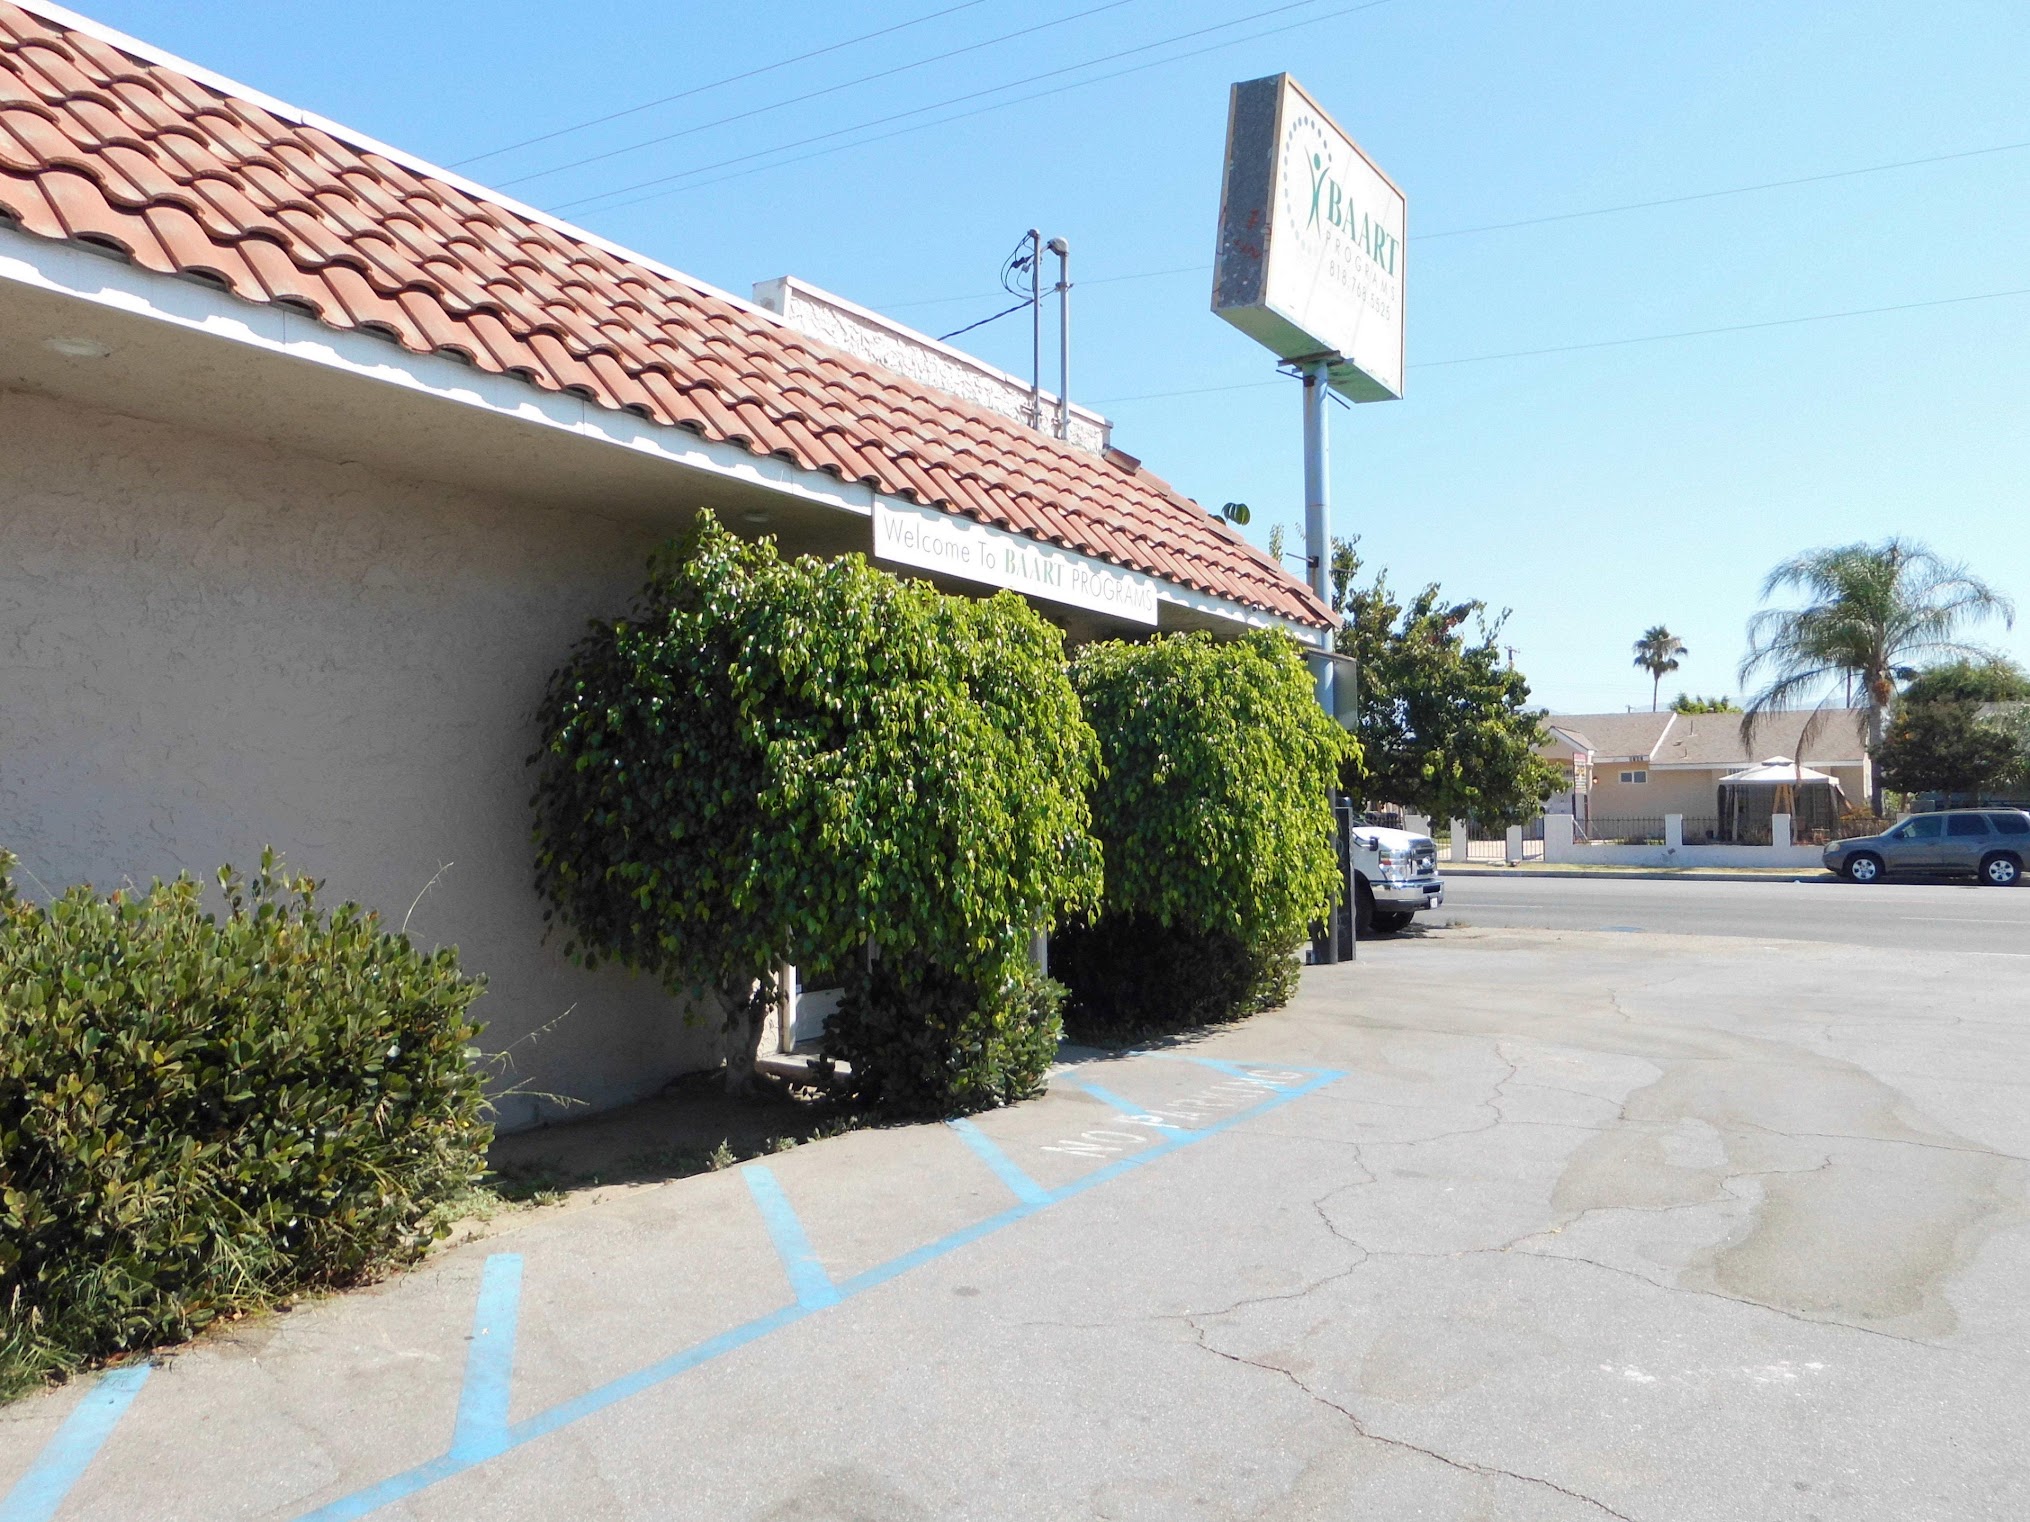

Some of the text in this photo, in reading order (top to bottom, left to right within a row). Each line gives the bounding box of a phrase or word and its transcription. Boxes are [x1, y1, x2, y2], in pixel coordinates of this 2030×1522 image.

[1325, 229, 1395, 301] PROGRAMS
[1326, 176, 1400, 278] BAART
[883, 513, 1153, 612] Welcome To BAART PROGRAMS
[1040, 1070, 1303, 1158] NO PARKING
